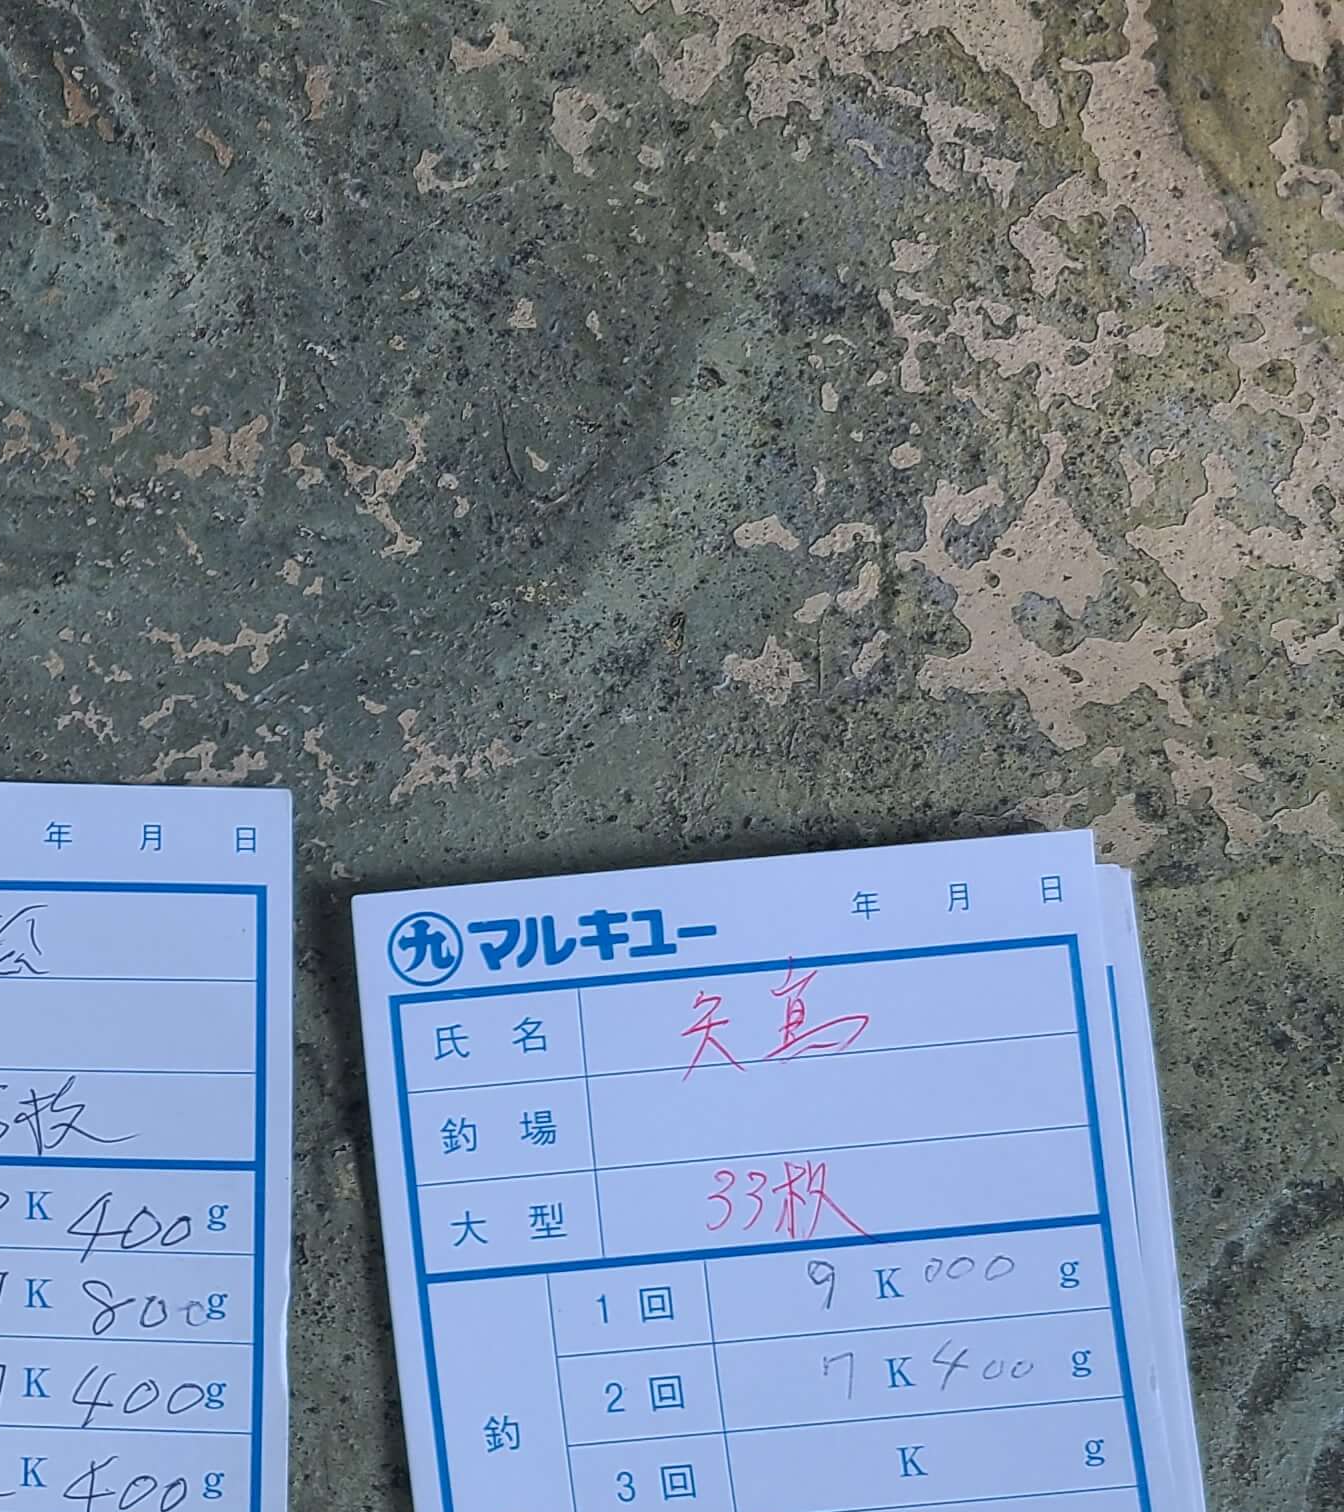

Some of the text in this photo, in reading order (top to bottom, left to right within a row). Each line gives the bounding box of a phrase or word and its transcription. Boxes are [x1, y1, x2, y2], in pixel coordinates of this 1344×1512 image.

[43, 821, 257, 854] 年 月 日
[851, 875, 1063, 921] 年 月 日
[467, 908, 718, 973] マルキュー
[434, 1016, 547, 1061] 氏名
[439, 1109, 557, 1155] 釣場
[450, 1202, 568, 1247] 大型
[596, 1287, 675, 1324] 1回
[605, 1376, 685, 1414] 2回
[616, 1463, 697, 1503] 3回
